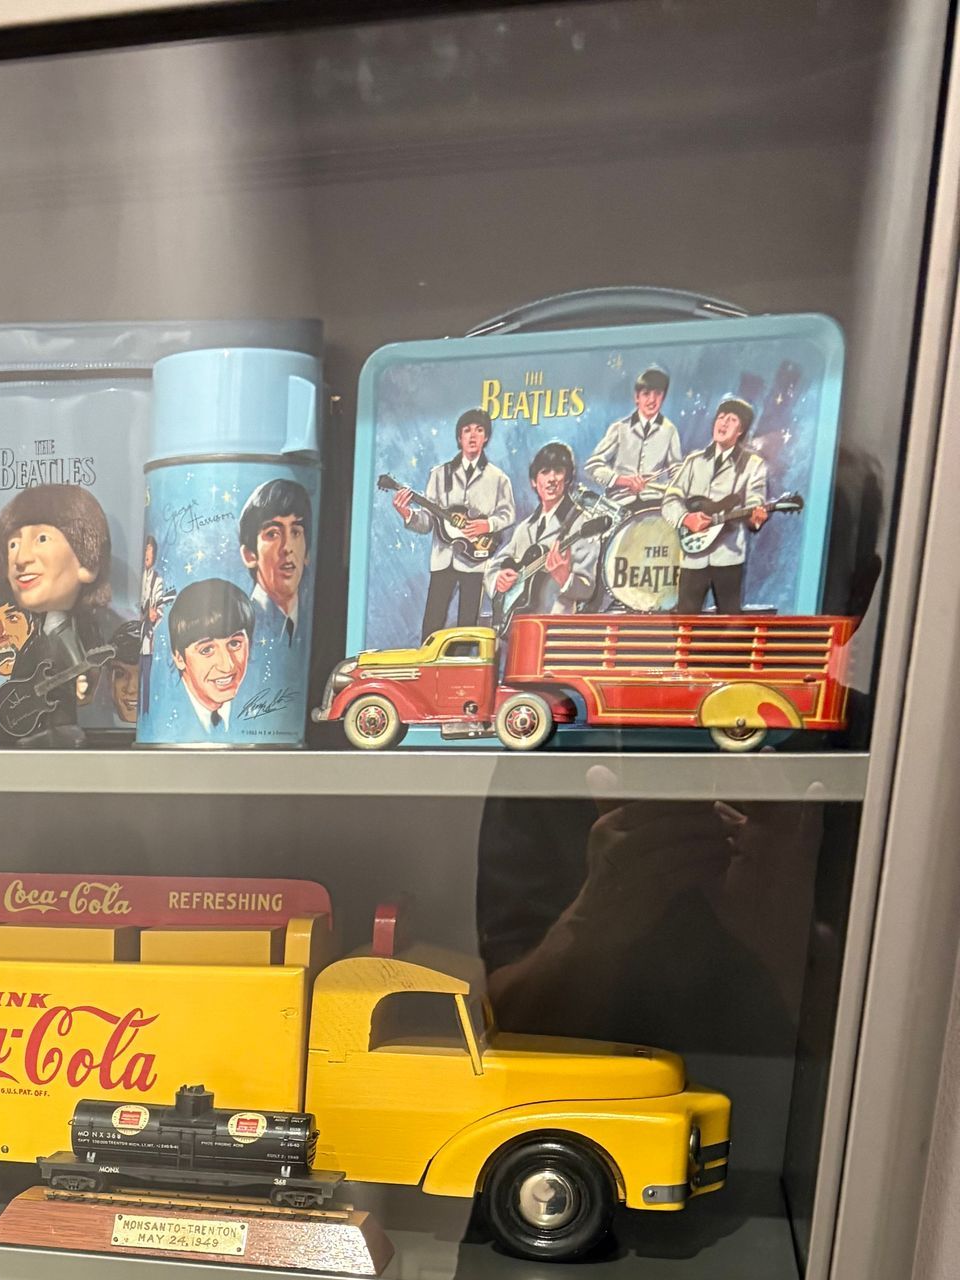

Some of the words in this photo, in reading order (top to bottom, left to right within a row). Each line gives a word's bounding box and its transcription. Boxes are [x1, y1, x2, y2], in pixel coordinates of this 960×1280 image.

[481, 379, 585, 425] BEATLES
[34, 439, 55, 455] THE
[644, 546, 669, 559] THE
[4, 880, 133, 915] Coca-Cola
[169, 891, 283, 912] REFRESHING
[99, 1166, 120, 1174] MONX
[123, 1220, 237, 1238] MONSANTO-TRENTON
[138, 1233, 165, 1244] MAY
